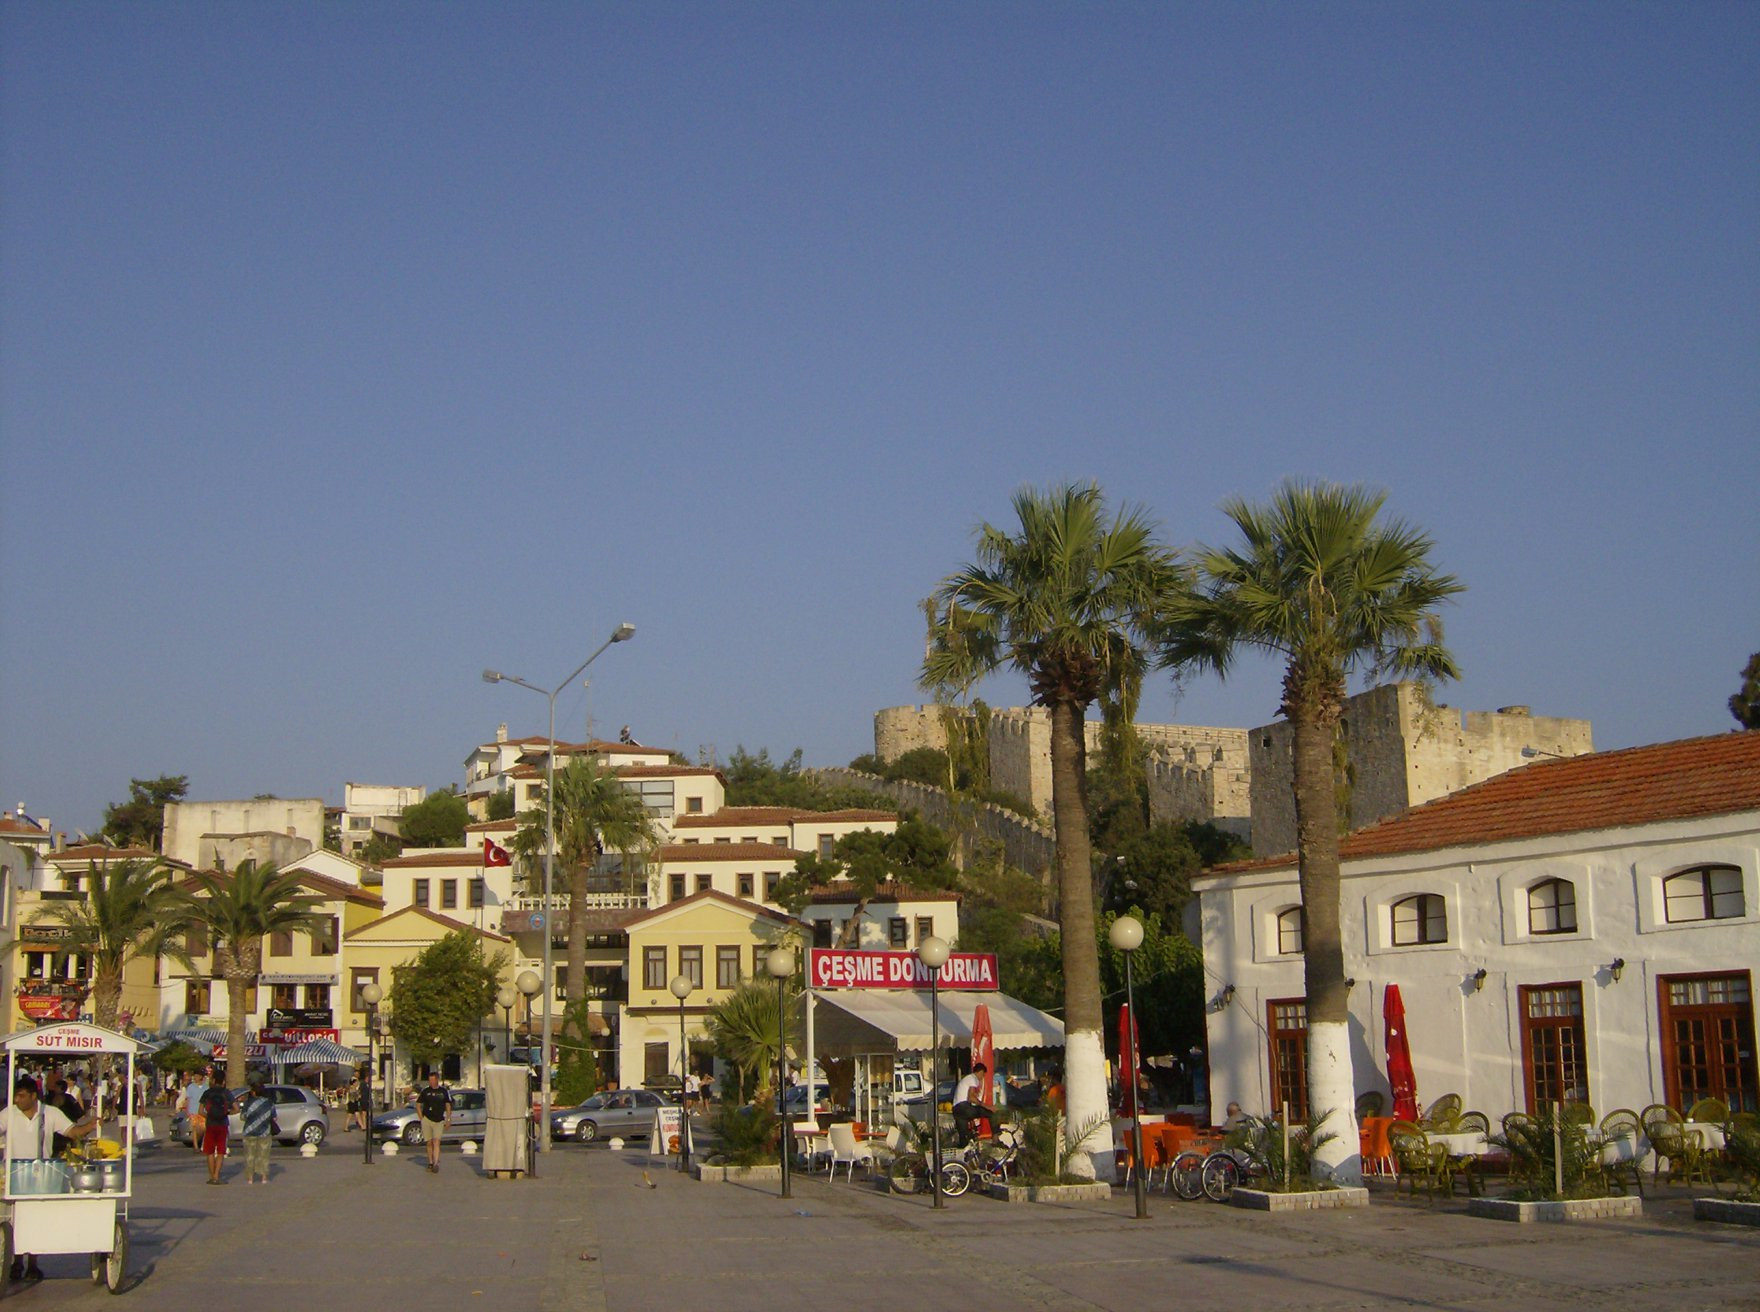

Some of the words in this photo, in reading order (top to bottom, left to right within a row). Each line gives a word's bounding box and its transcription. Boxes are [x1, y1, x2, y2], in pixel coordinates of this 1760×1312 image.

[818, 955, 884, 987] ÇEŞME
[36, 1033, 62, 1047] SÜT
[66, 1036, 103, 1048] MISIR
